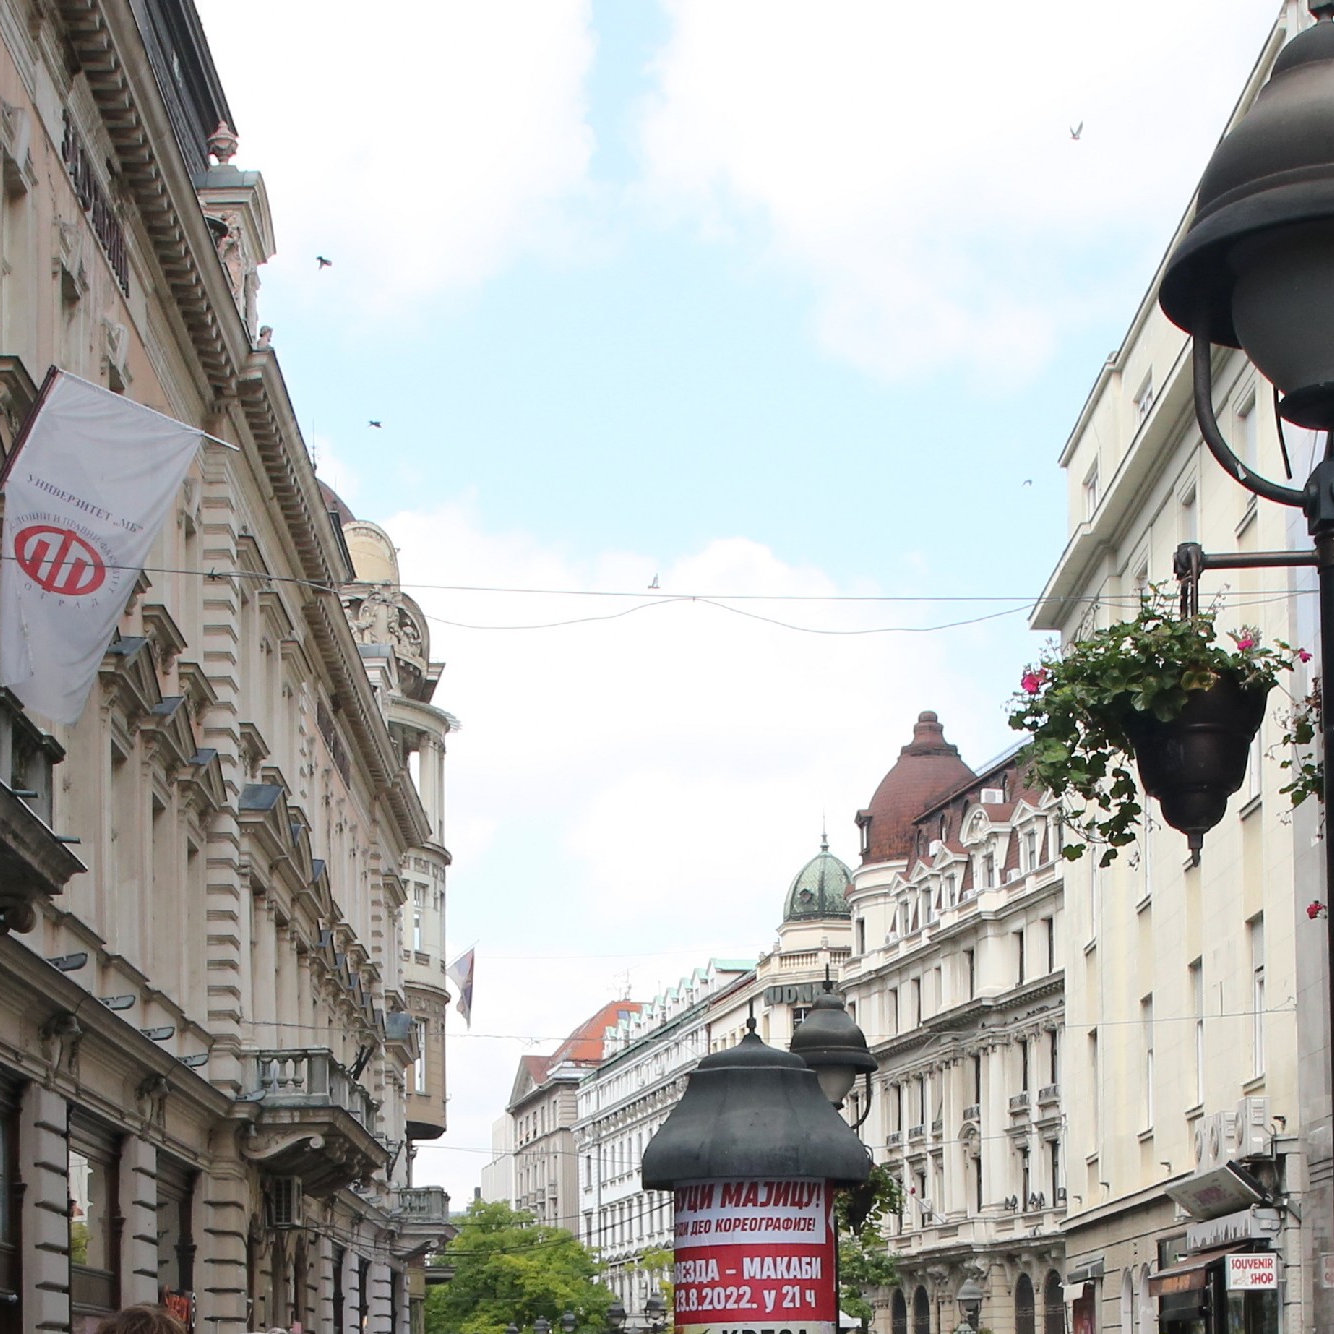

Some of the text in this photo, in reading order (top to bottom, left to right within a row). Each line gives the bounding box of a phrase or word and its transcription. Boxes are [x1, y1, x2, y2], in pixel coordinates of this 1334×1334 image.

[27, 473, 112, 520] УНИВЕРЗИТЕТ
[720, 1180, 821, 1210] МАЈИЦУ!
[690, 1220, 712, 1236] ДЕО
[715, 1217, 816, 1233] КОРЕОГРАФИЈЕ!
[676, 1259, 720, 1284] ВЕЗДА
[743, 1257, 821, 1280] МАКАБИ
[1231, 1258, 1274, 1270] SOUVENIR
[1250, 1272, 1274, 1285] SHOP
[782, 1286, 801, 1308] 21
